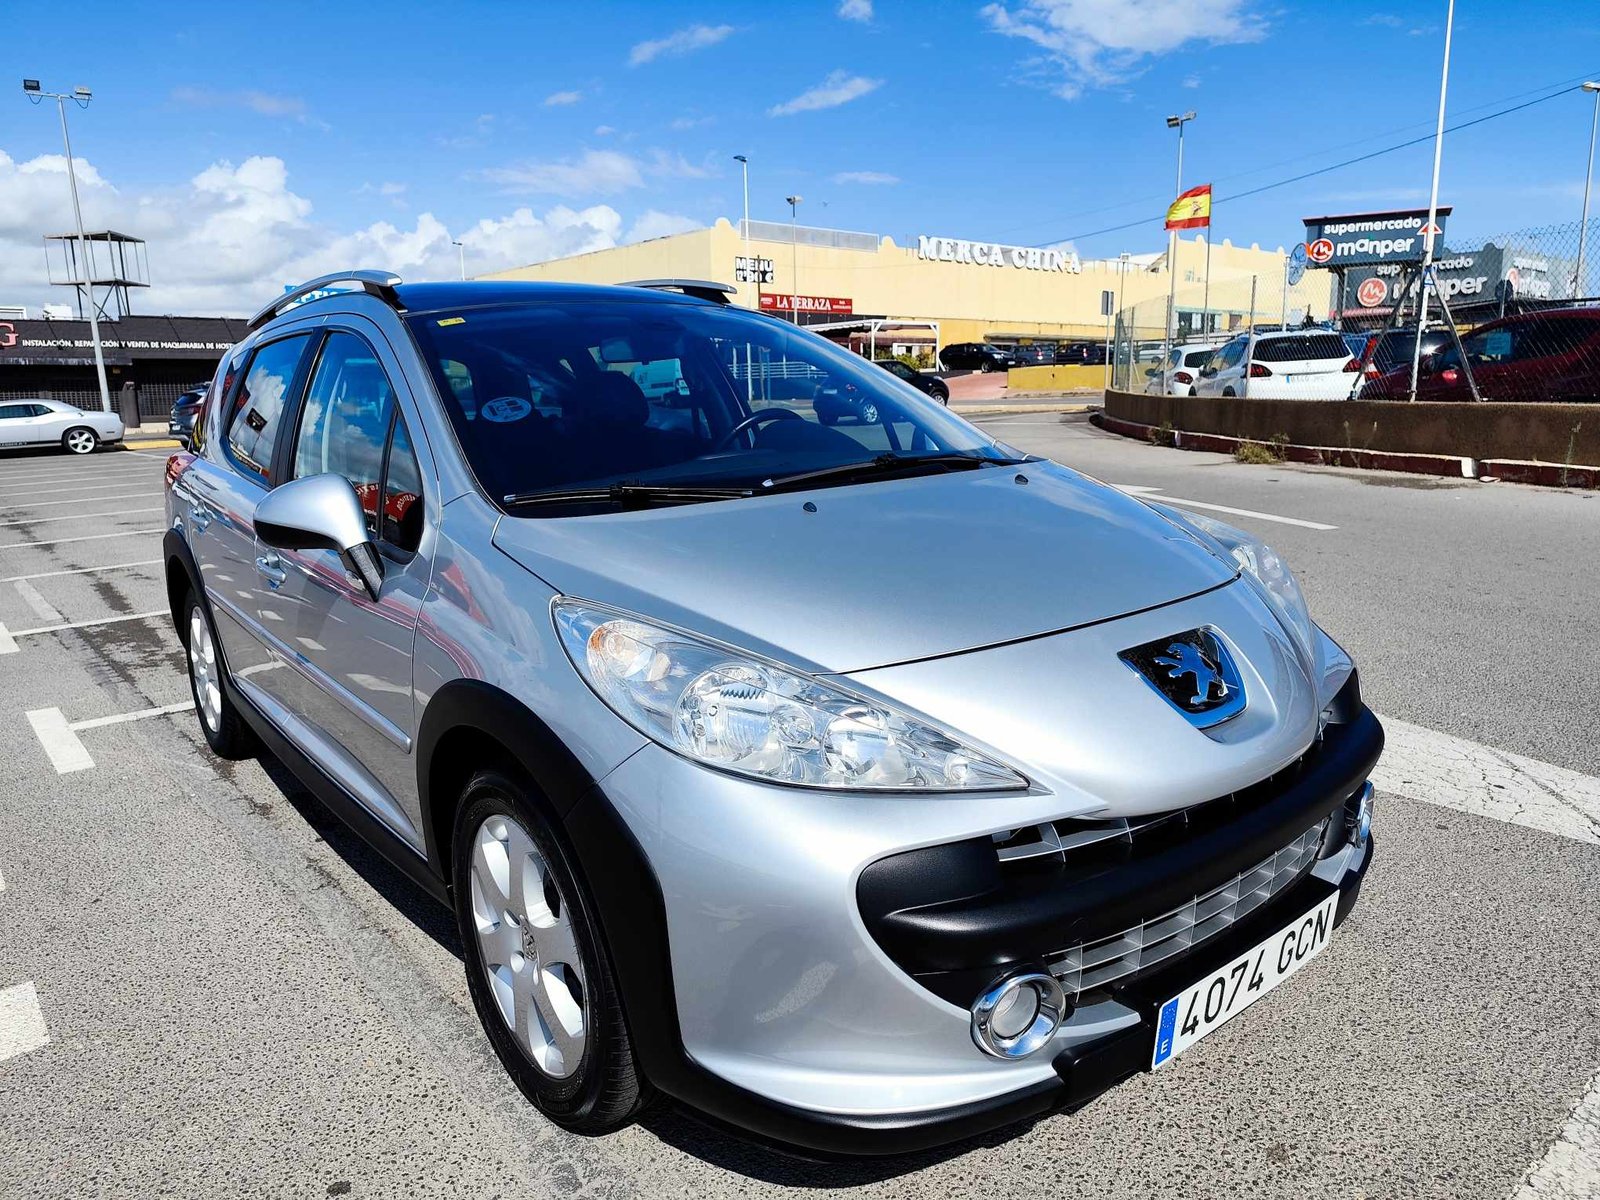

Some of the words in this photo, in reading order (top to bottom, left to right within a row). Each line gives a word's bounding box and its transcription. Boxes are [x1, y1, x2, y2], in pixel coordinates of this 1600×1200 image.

[1324, 216, 1421, 236] supermercado
[918, 235, 1004, 267] MERCA
[1011, 247, 1082, 275] CHINA
[1336, 238, 1415, 258] manper
[776, 296, 789, 309] LA
[790, 296, 832, 310] TERRAZA
[127, 341, 149, 349] VENTA
[151, 341, 159, 349] DE
[161, 341, 205, 350] MAQUINARIA
[206, 342, 214, 350] DE
[1180, 949, 1265, 1037] 4074
[1277, 902, 1332, 975] GCN
[1160, 1039, 1169, 1055] E
